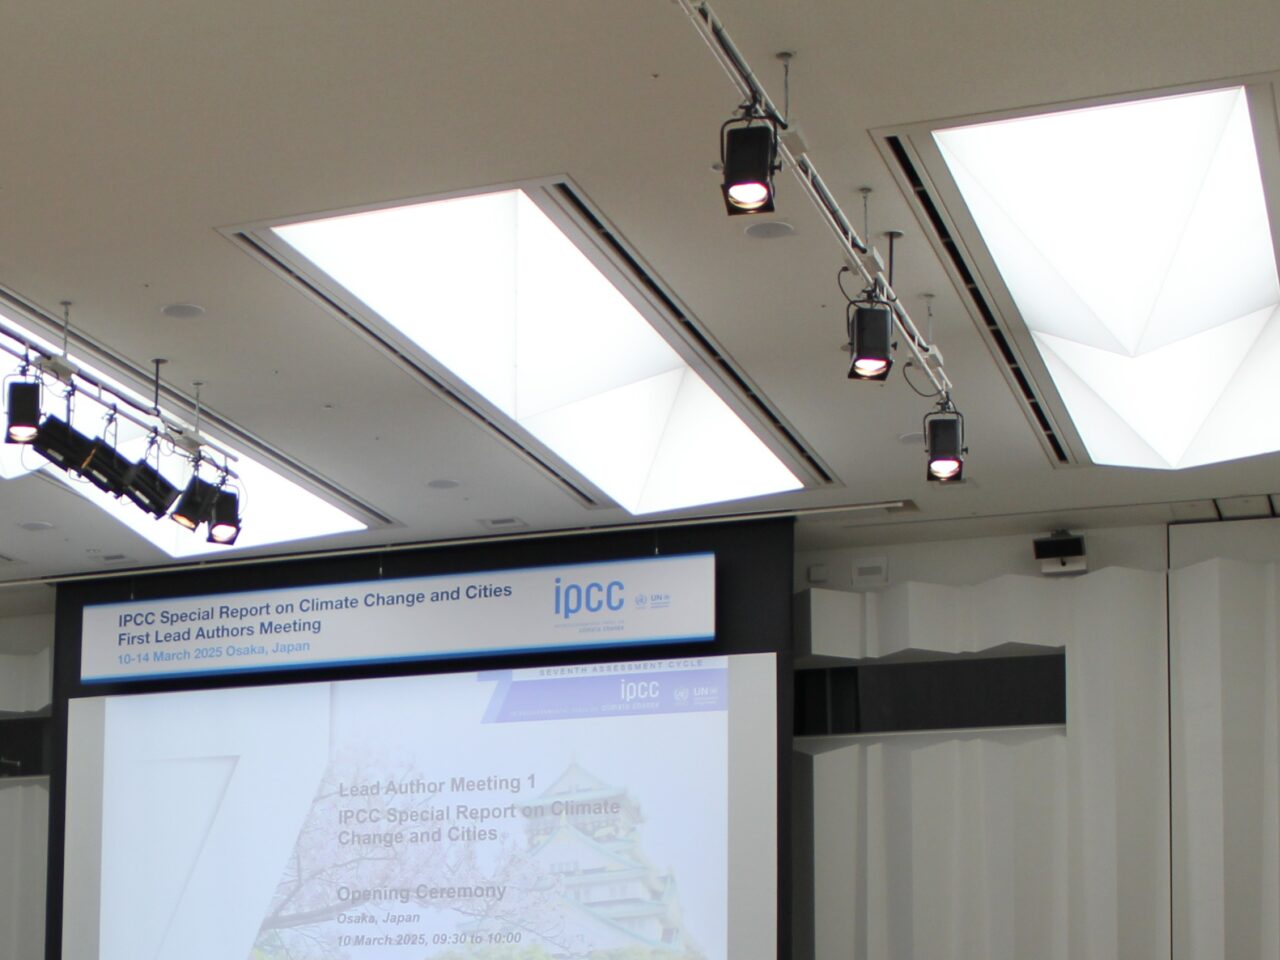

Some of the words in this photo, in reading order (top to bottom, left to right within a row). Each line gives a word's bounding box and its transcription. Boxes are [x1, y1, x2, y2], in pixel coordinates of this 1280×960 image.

[118, 611, 156, 628] IPCC
[160, 607, 215, 625] Special
[219, 604, 271, 622] Report
[274, 601, 295, 614] on
[299, 596, 360, 613] Climate
[363, 591, 426, 607] Change
[430, 585, 461, 602] and
[465, 583, 513, 600] Cities
[554, 577, 625, 619] ipcc
[118, 630, 150, 647] First
[154, 628, 192, 644] Lead
[195, 623, 255, 641] Authors
[259, 619, 321, 636] Meeting
[118, 651, 150, 665] 10-14
[153, 647, 191, 663] March
[194, 645, 223, 659] 2025
[226, 643, 269, 659] Osaka,
[272, 640, 311, 655] Japan
[539, 667, 588, 677] SEVENTH
[592, 662, 663, 673] ASSESSMENT
[668, 659, 703, 668] CYCLE
[621, 679, 660, 702] ipcc
[339, 781, 380, 797] Lead
[385, 778, 445, 795] Author
[451, 776, 521, 795] Meeting
[527, 774, 536, 789] 1
[338, 808, 380, 825] IPCC
[385, 805, 450, 825] Special
[456, 804, 516, 822] Report
[522, 803, 545, 817] on
[551, 800, 620, 816] Climate
[338, 830, 404, 848] Change
[409, 827, 442, 844] and
[447, 825, 498, 842] Cities
[337, 886, 410, 904] Opening
[415, 883, 507, 901] Ceremony
[337, 912, 379, 926] Osaka,
[382, 911, 421, 926] Japan
[337, 935, 352, 947] 10
[354, 934, 393, 947] March
[396, 934, 430, 947] 2025,
[432, 933, 467, 946] 09:30
[470, 933, 483, 945] to
[487, 931, 522, 944] 10:00
